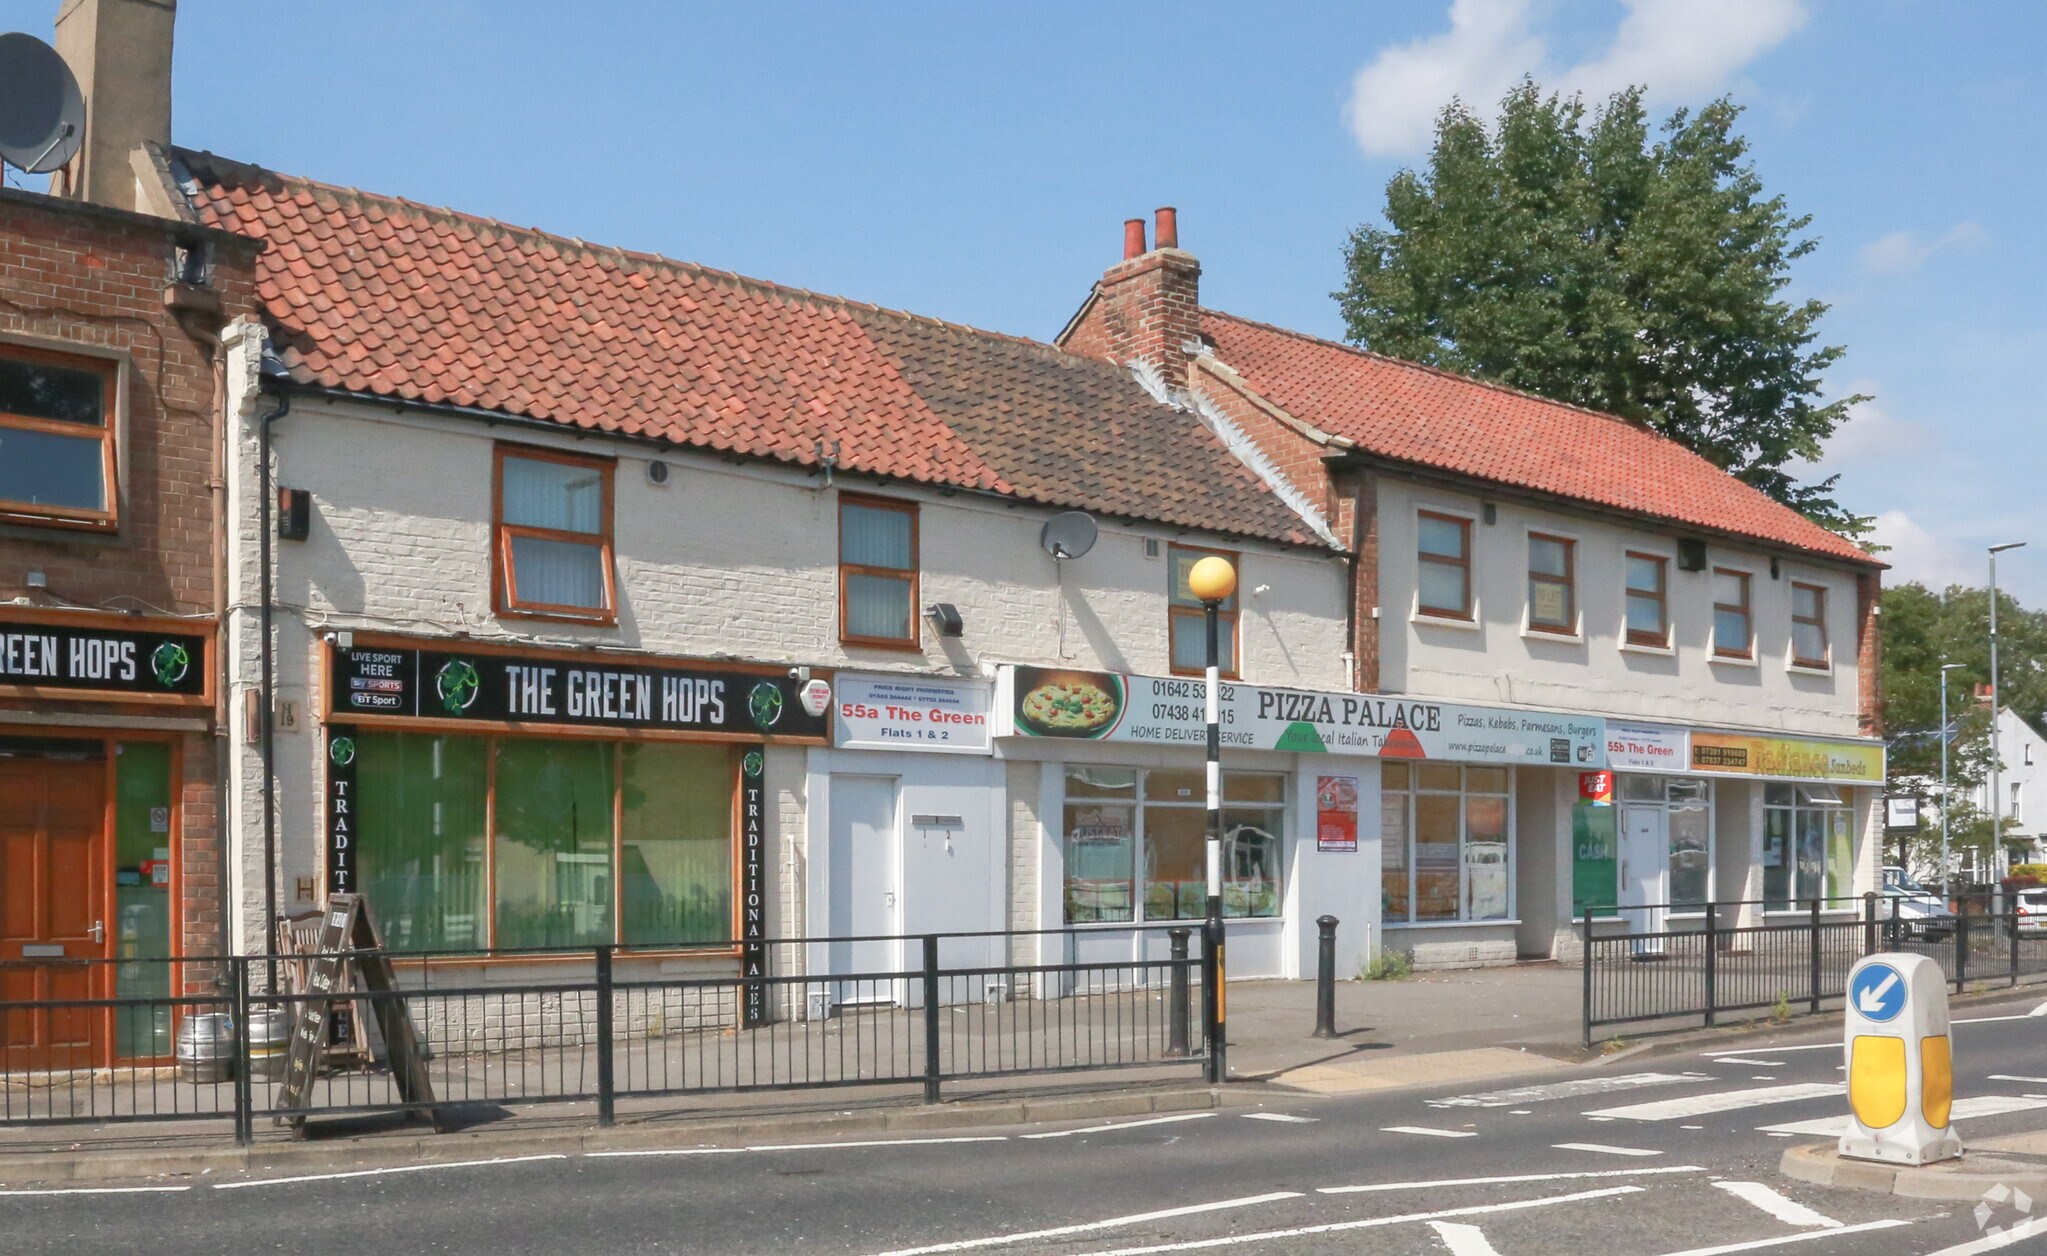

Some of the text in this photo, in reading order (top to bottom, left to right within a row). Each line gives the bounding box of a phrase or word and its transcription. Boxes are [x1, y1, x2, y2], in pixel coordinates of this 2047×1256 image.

[70, 637, 136, 680] HOPS
[351, 652, 402, 664] LIVE SPORT
[361, 664, 393, 677] HERE
[353, 680, 400, 690] sky SPORTS
[1152, 680, 1234, 701] 01642 5322
[358, 695, 396, 706] BT Sport
[506, 665, 724, 724] THE GREEN HOPS
[842, 704, 985, 725] 55a The Green
[1152, 704, 1234, 724] 07438 4115
[1258, 691, 1440, 732] PIZZA PALACE
[881, 728, 949, 739] Flats 1 & 2
[1131, 726, 1161, 738] HOME
[1165, 728, 1208, 741] DELIVER
[1457, 714, 1597, 739] Pizzas, Kebabs, Parmesans, Burgers
[1285, 729, 1309, 743] Your
[1338, 733, 1369, 746] Italian
[1608, 741, 1674, 755] 55b The Green
[1831, 758, 1867, 776] Sunbeds
[1584, 774, 1606, 785] JUST
[1588, 783, 1606, 792] EAT
[945, 829, 951, 839] 2
[1580, 844, 1608, 859] CASH
